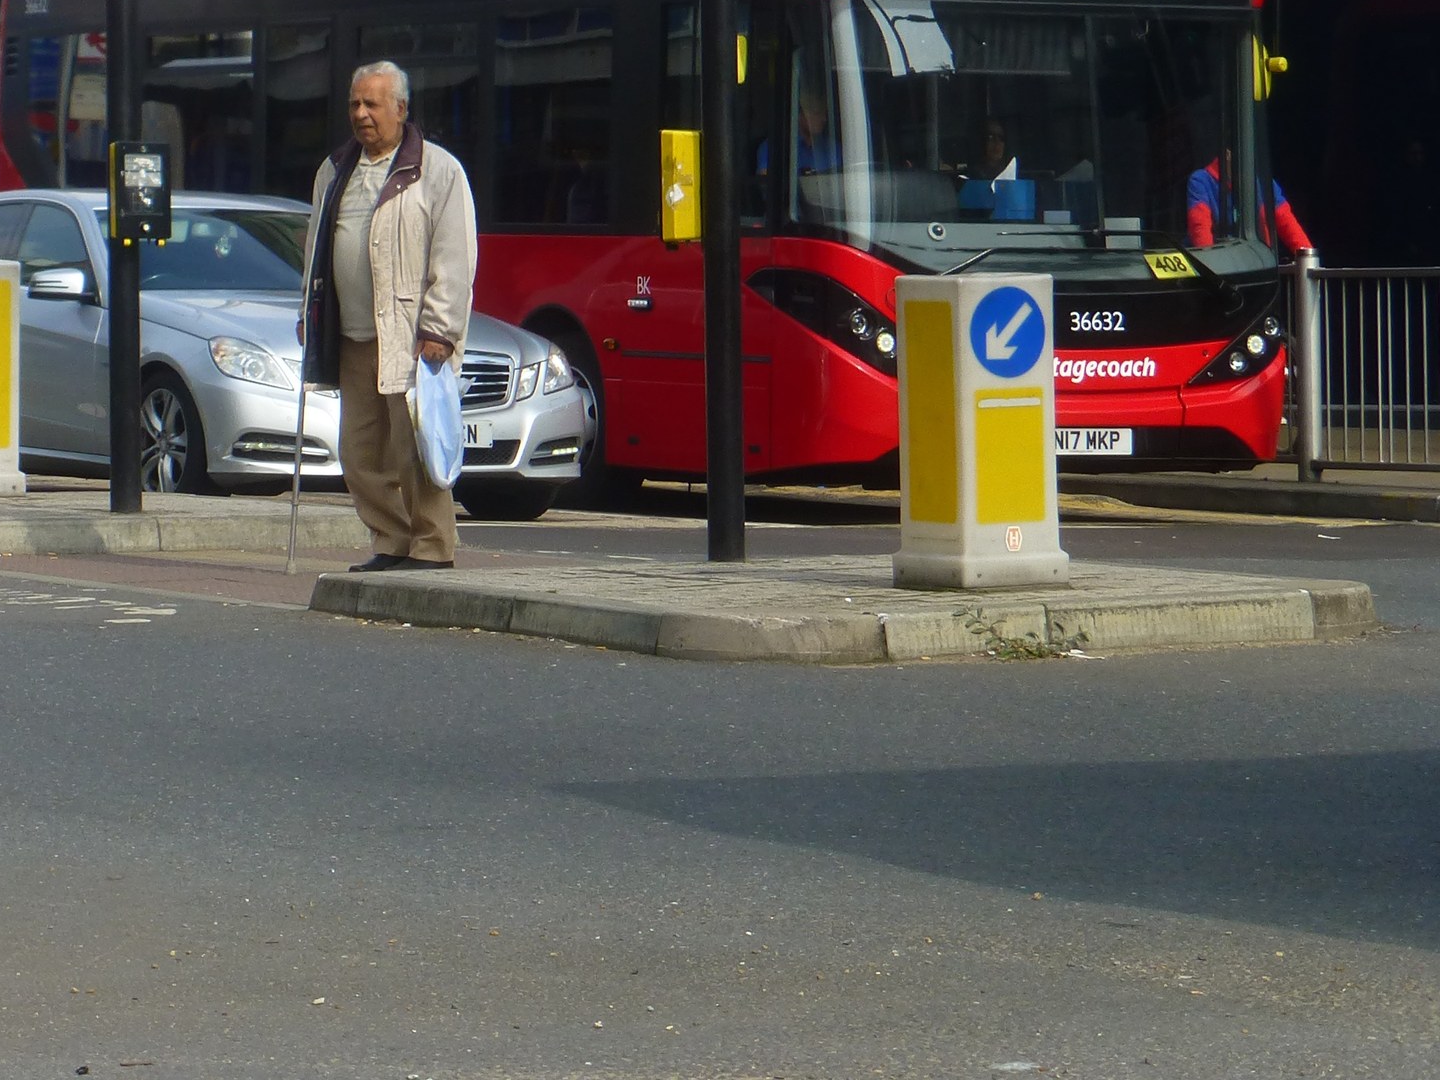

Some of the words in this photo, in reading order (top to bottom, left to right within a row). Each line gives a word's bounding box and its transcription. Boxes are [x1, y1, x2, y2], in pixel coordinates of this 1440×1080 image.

[1155, 255, 1188, 273] 408
[637, 275, 651, 295] BK
[1070, 311, 1125, 331] 36632
[1053, 356, 1156, 384] tagecoach
[1055, 430, 1081, 450] N17
[1086, 430, 1120, 450] MKP
